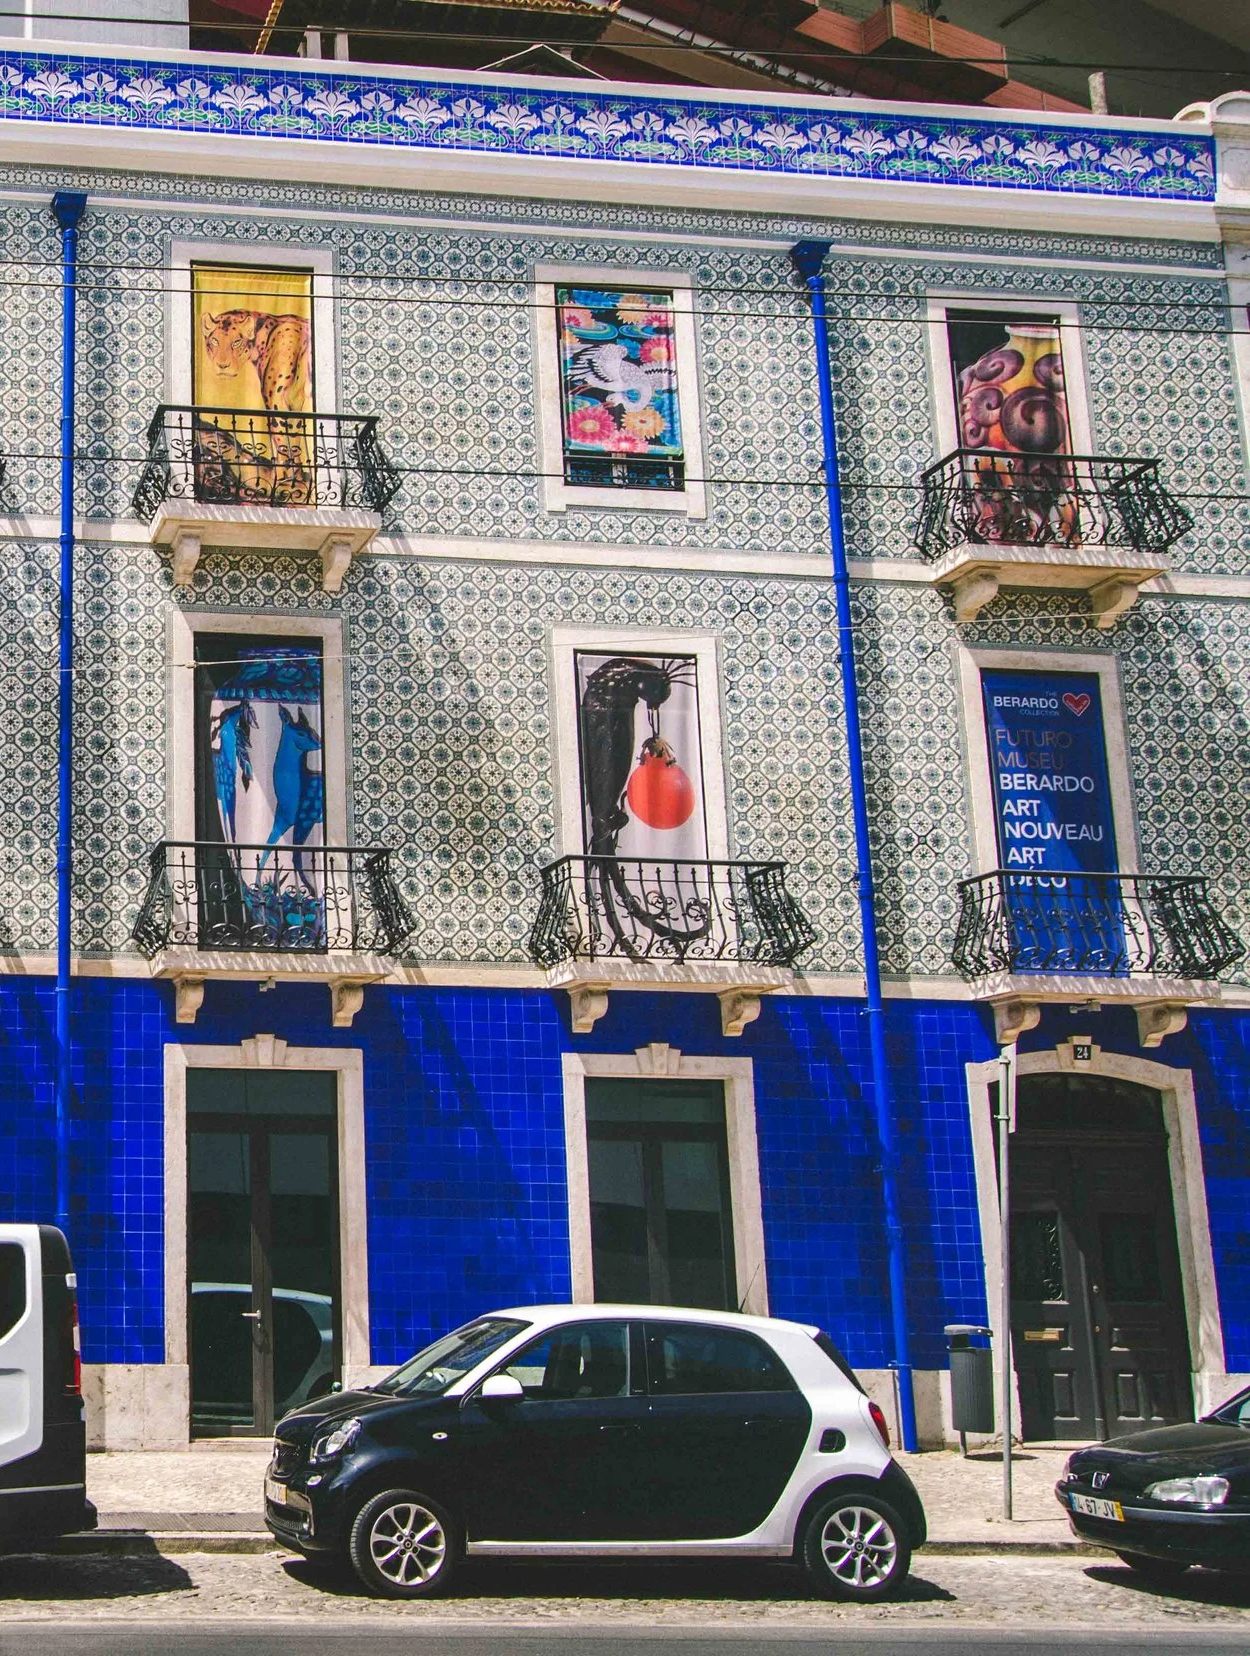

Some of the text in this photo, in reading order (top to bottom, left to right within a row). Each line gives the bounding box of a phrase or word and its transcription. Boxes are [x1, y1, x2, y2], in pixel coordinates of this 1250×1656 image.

[993, 696, 1058, 709] BERARDO
[1020, 708, 1059, 716] COLLECTION
[995, 728, 1072, 748] FUTURO
[997, 751, 1063, 770] MUSEU
[1000, 773, 1095, 793] BERARDO
[1002, 799, 1040, 816] ART
[1004, 821, 1103, 841] NOUVEAU
[1007, 847, 1046, 864] ART
[1077, 1046, 1088, 1059] 24
